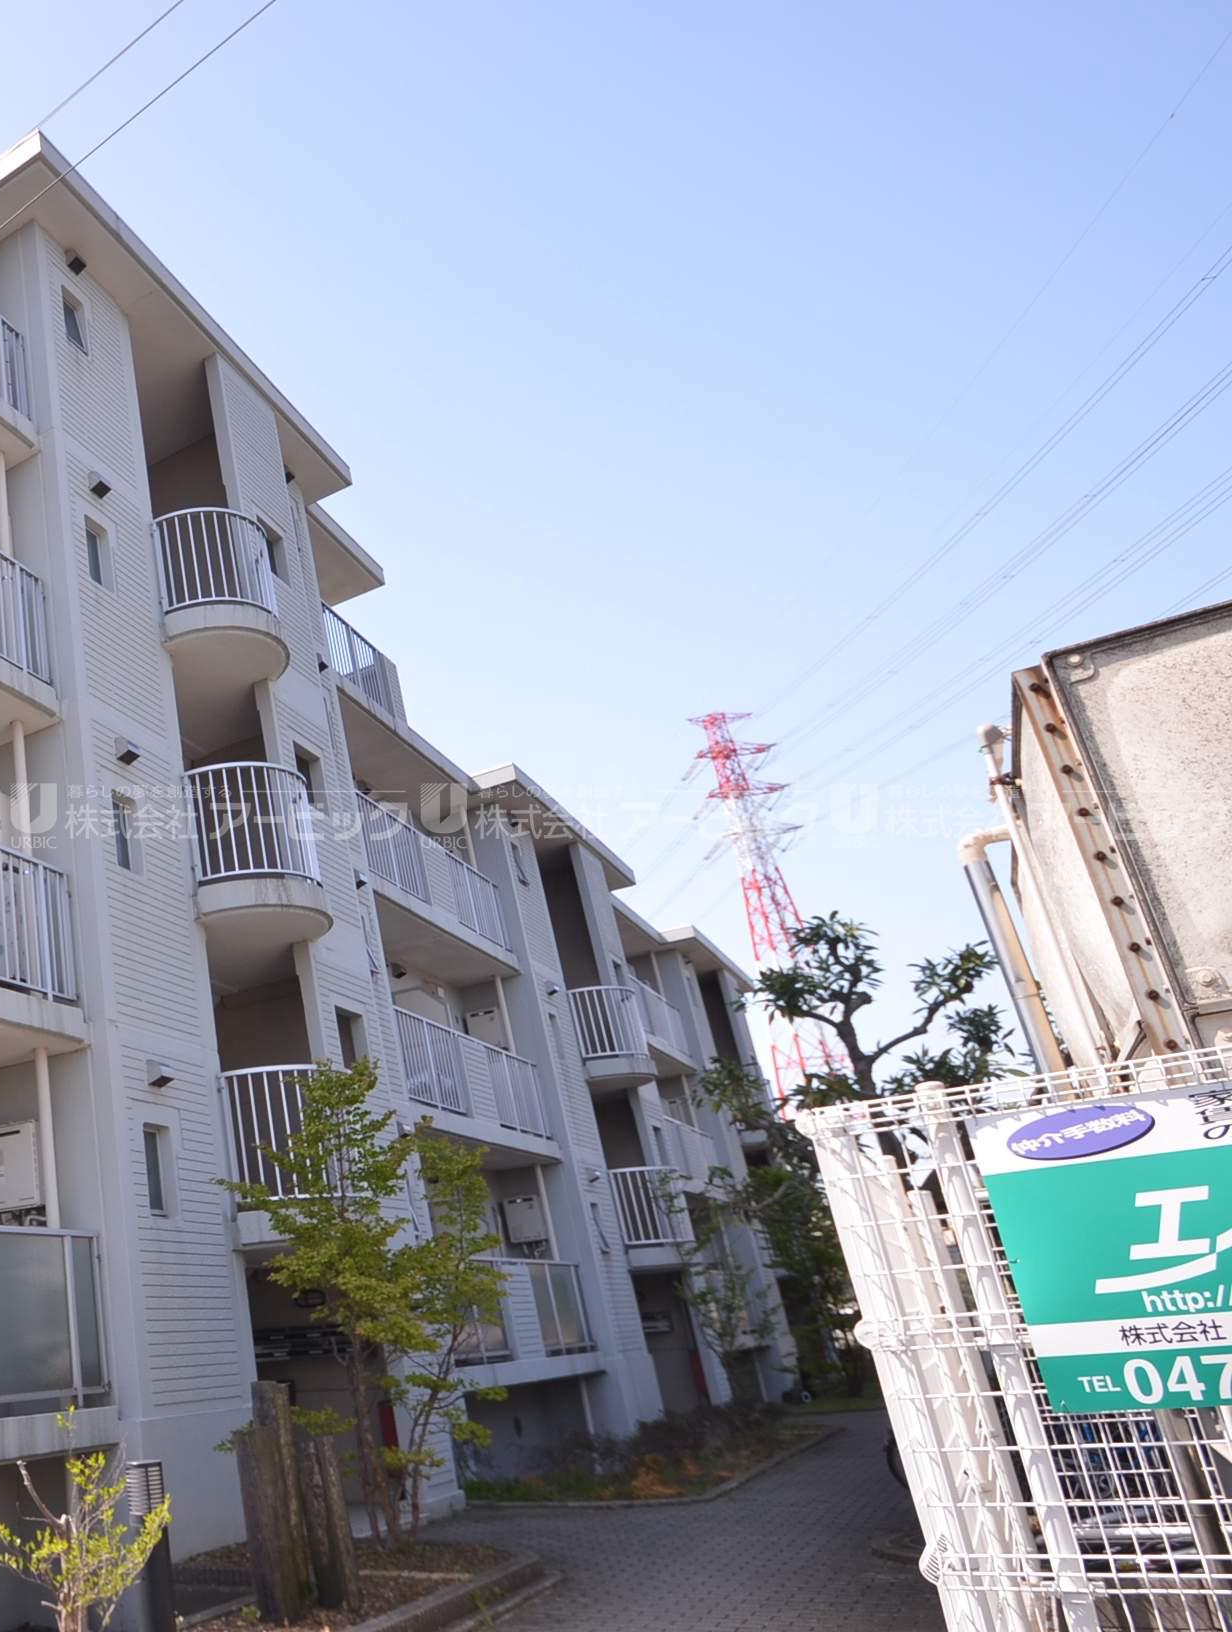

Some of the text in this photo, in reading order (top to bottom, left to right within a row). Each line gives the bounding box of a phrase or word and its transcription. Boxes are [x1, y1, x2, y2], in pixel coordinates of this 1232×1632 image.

[1010, 1108, 1147, 1155] 仲介手数料
[1119, 1318, 1228, 1347] 株式会社
[1077, 1353, 1232, 1405] TEL 047
